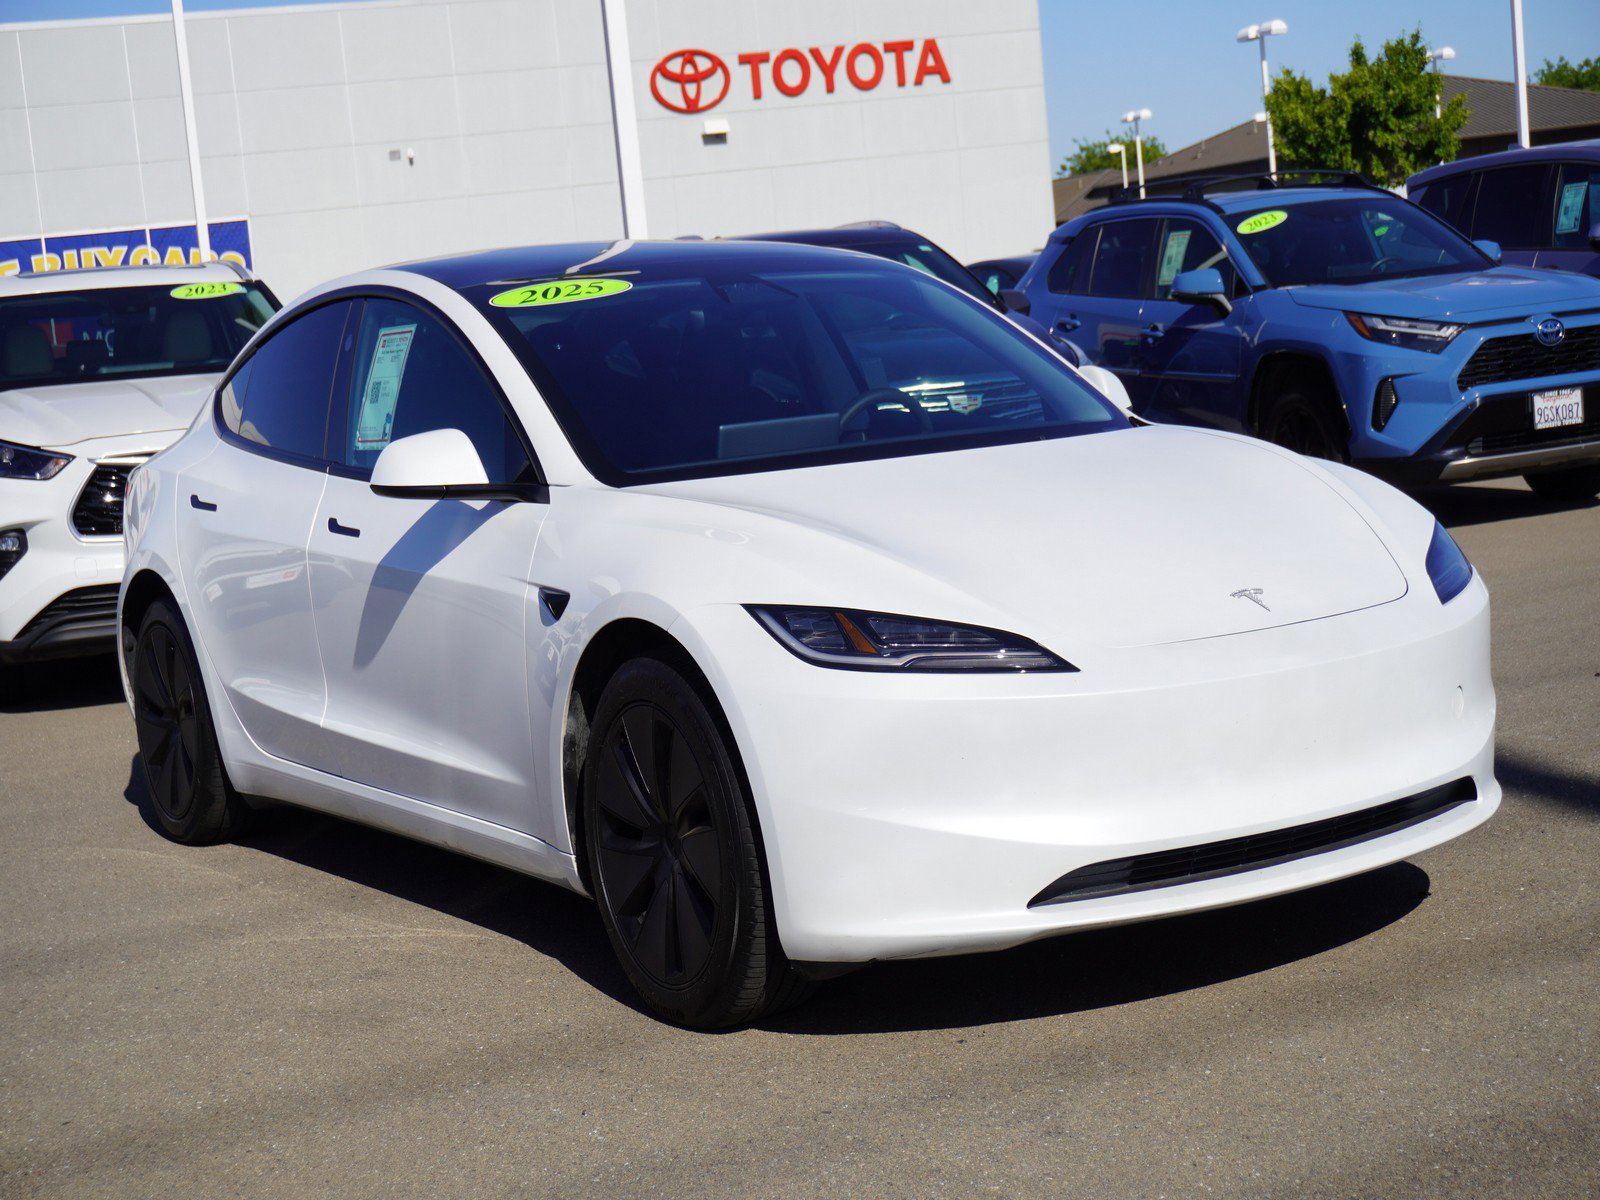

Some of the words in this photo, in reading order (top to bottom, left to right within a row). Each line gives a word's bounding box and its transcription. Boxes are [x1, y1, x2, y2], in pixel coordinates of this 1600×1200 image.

[738, 38, 951, 99] TOYOTA
[1246, 213, 1277, 231] 2023
[184, 283, 227, 298] 2023
[519, 281, 603, 304] 2025
[1537, 402, 1579, 424] 9GSK087
